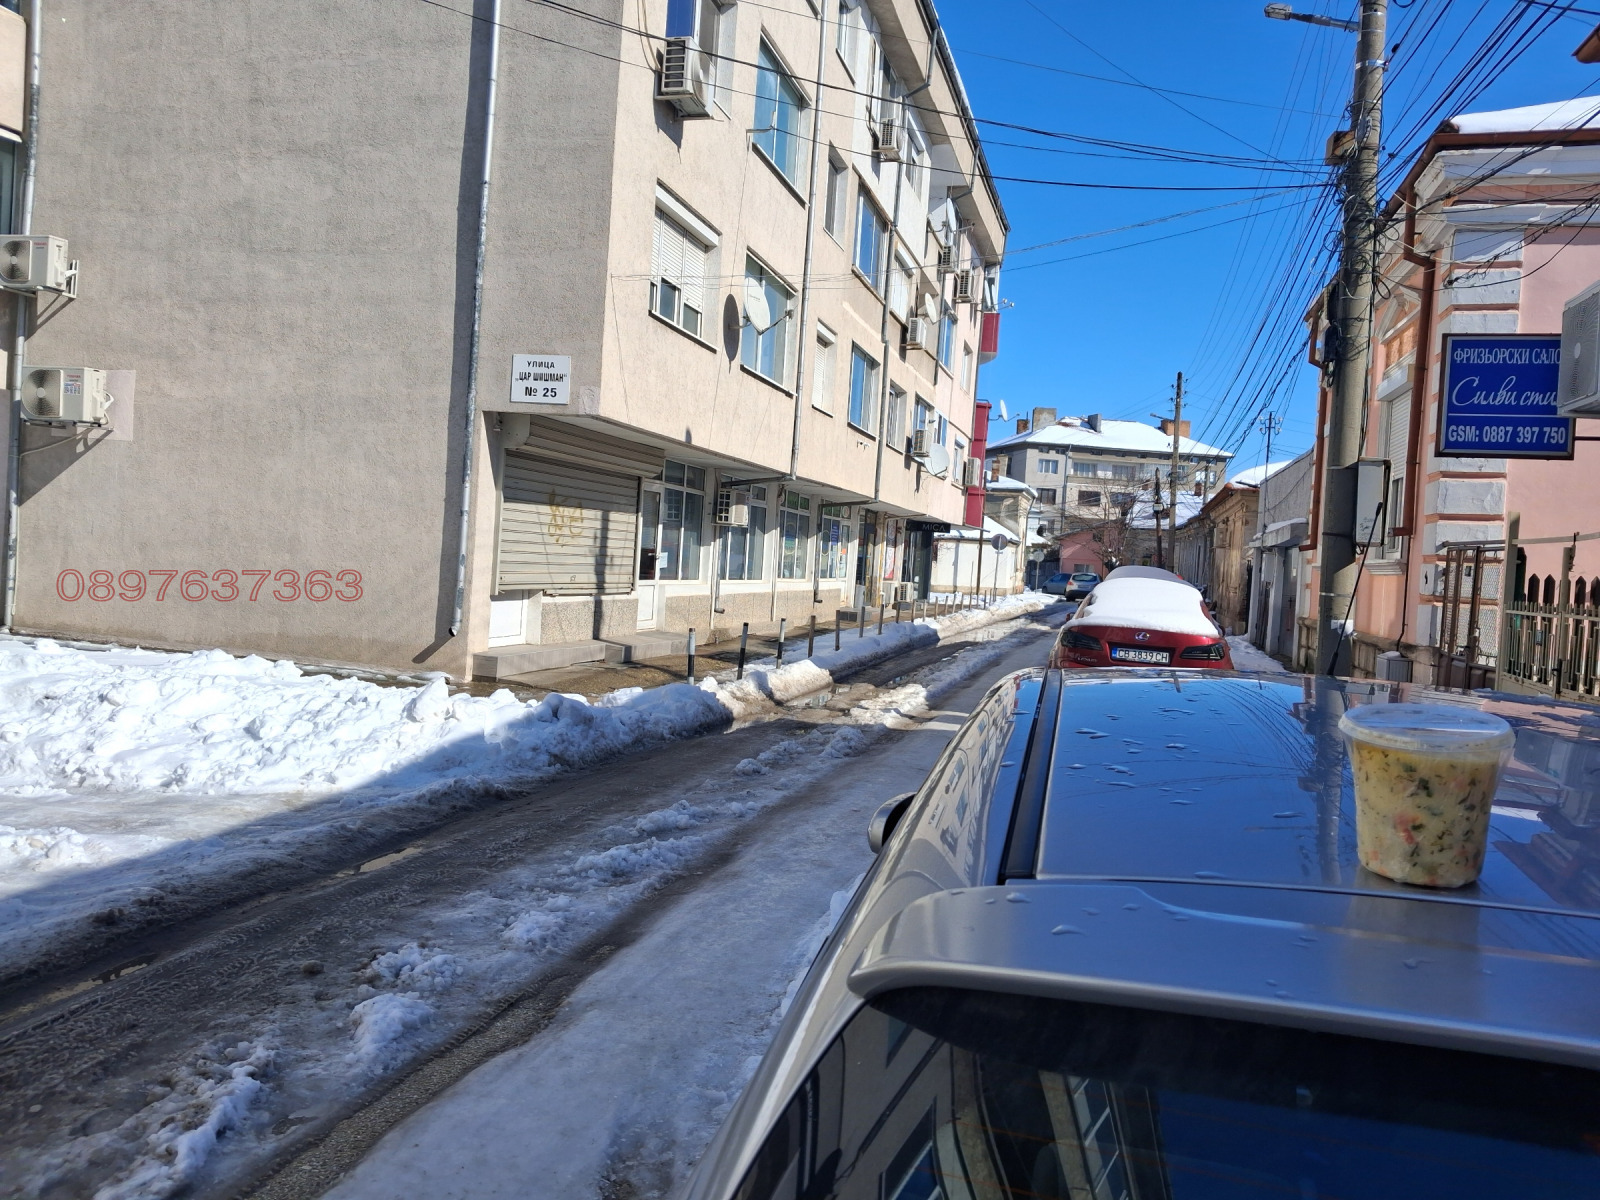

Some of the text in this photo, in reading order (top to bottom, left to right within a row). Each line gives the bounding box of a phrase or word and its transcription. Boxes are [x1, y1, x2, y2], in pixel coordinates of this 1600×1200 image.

[1454, 348, 1560, 364] ФРИЗЬОРСКИ САЛО
[527, 361, 555, 369] УЛИЦА
[542, 388, 557, 398] 25
[1520, 391, 1558, 406] сти
[1448, 425, 1566, 444] GSM: 0887 397 750
[1131, 651, 1154, 661] 3839
